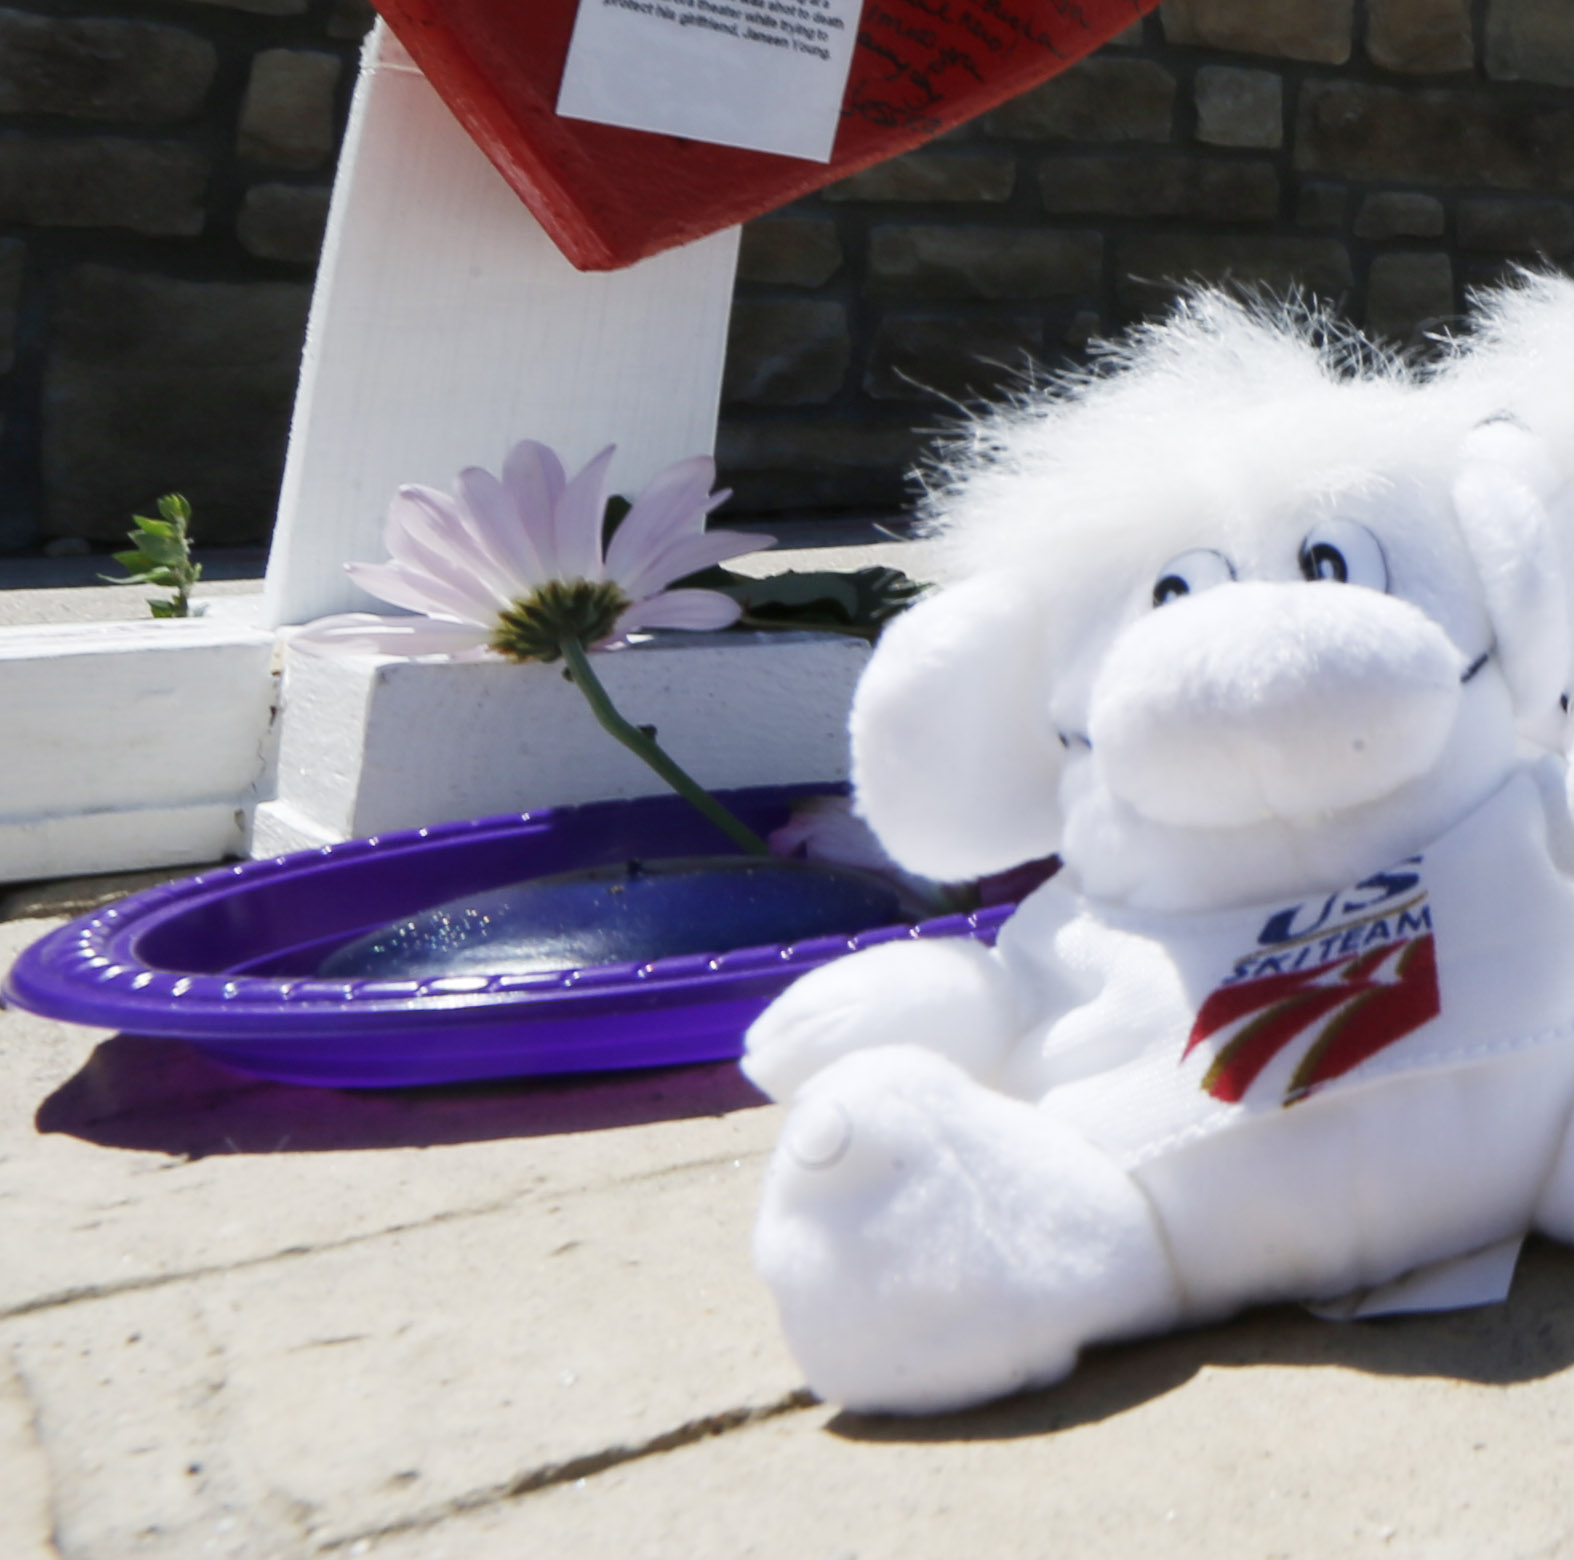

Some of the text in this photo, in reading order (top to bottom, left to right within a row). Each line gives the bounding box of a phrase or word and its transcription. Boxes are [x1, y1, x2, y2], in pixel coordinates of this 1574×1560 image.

[656, 5, 675, 20] his
[792, 39, 830, 60] Young.
[697, 0, 741, 18] theater
[745, 13, 777, 28] while
[780, 20, 815, 40] trying
[768, 2, 796, 16] shot
[813, 13, 844, 28] death
[1258, 855, 1424, 945] US
[1319, 903, 1433, 961] TEAM
